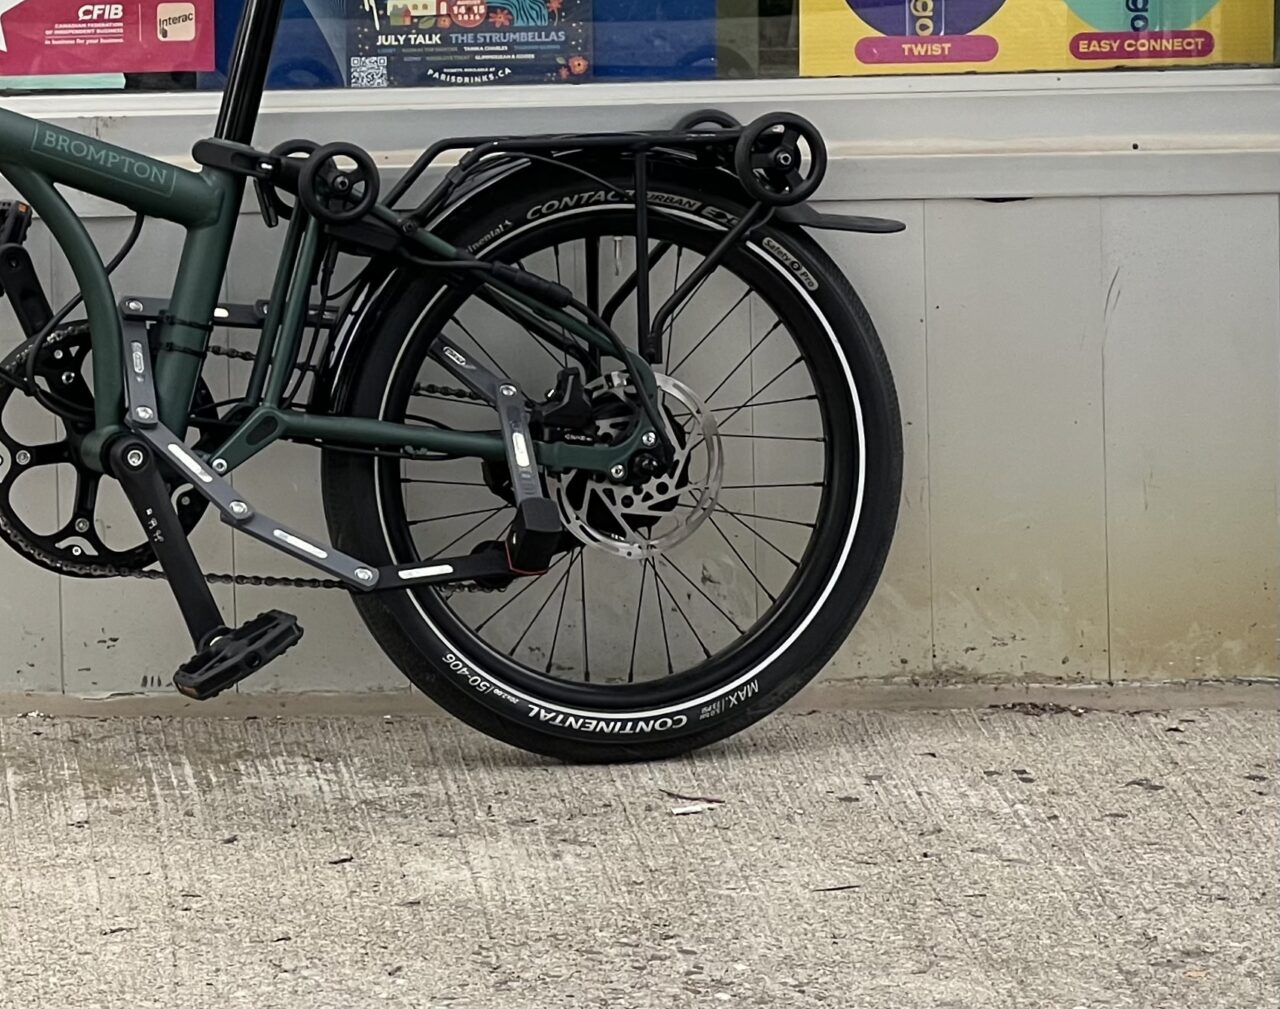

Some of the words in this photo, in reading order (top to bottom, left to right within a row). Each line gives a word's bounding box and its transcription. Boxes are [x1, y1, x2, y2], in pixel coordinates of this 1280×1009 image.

[78, 4, 123, 21] CFIB
[376, 34, 407, 46] JULY
[408, 34, 442, 45] TALK
[450, 33, 475, 44] THE
[477, 31, 566, 43] STRUMBELLAS
[1079, 38, 1120, 53] EASY
[1123, 37, 1205, 52] CONNECT
[901, 42, 952, 56] TWIST
[427, 66, 512, 84] PARISDRINKS.CA
[43, 130, 168, 185] BROMPTON
[527, 703, 687, 734] CONTINENTAL
